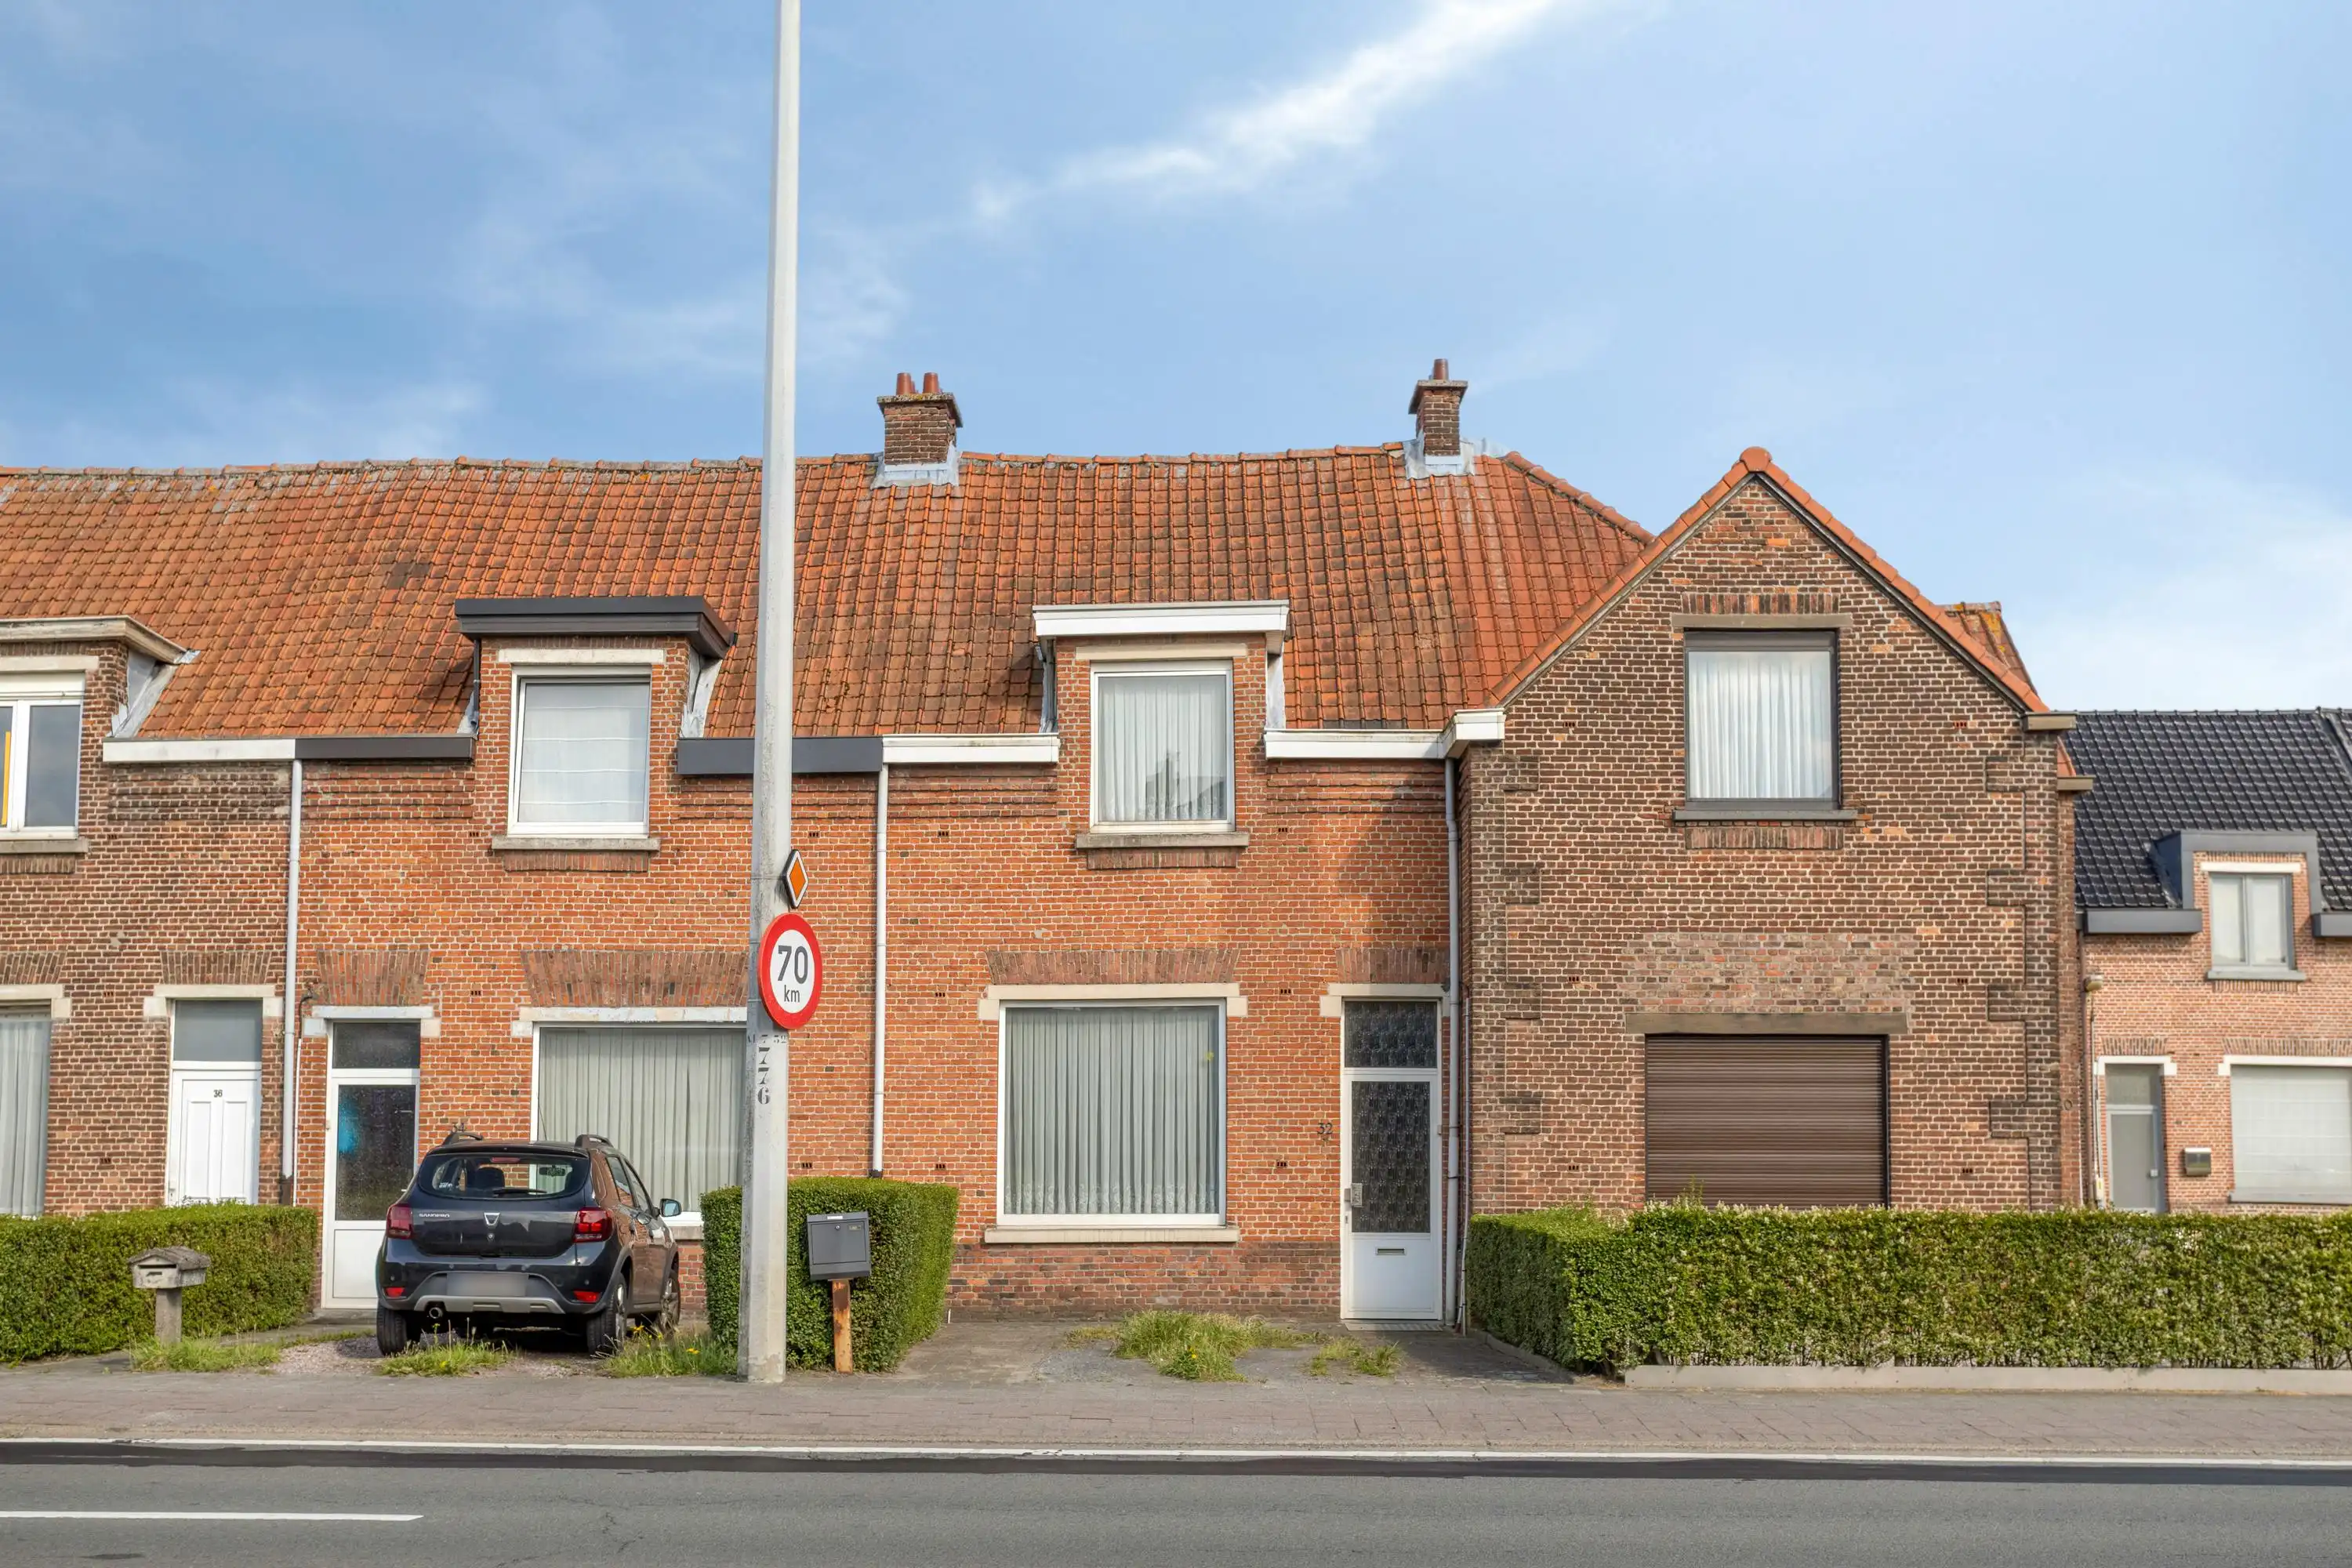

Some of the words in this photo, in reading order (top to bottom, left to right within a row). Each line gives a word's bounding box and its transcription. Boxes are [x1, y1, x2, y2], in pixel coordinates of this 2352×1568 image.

[778, 945, 808, 985] 70
[784, 984, 800, 1003] km
[213, 1089, 223, 1098] 36
[1316, 1122, 1333, 1134] 32
